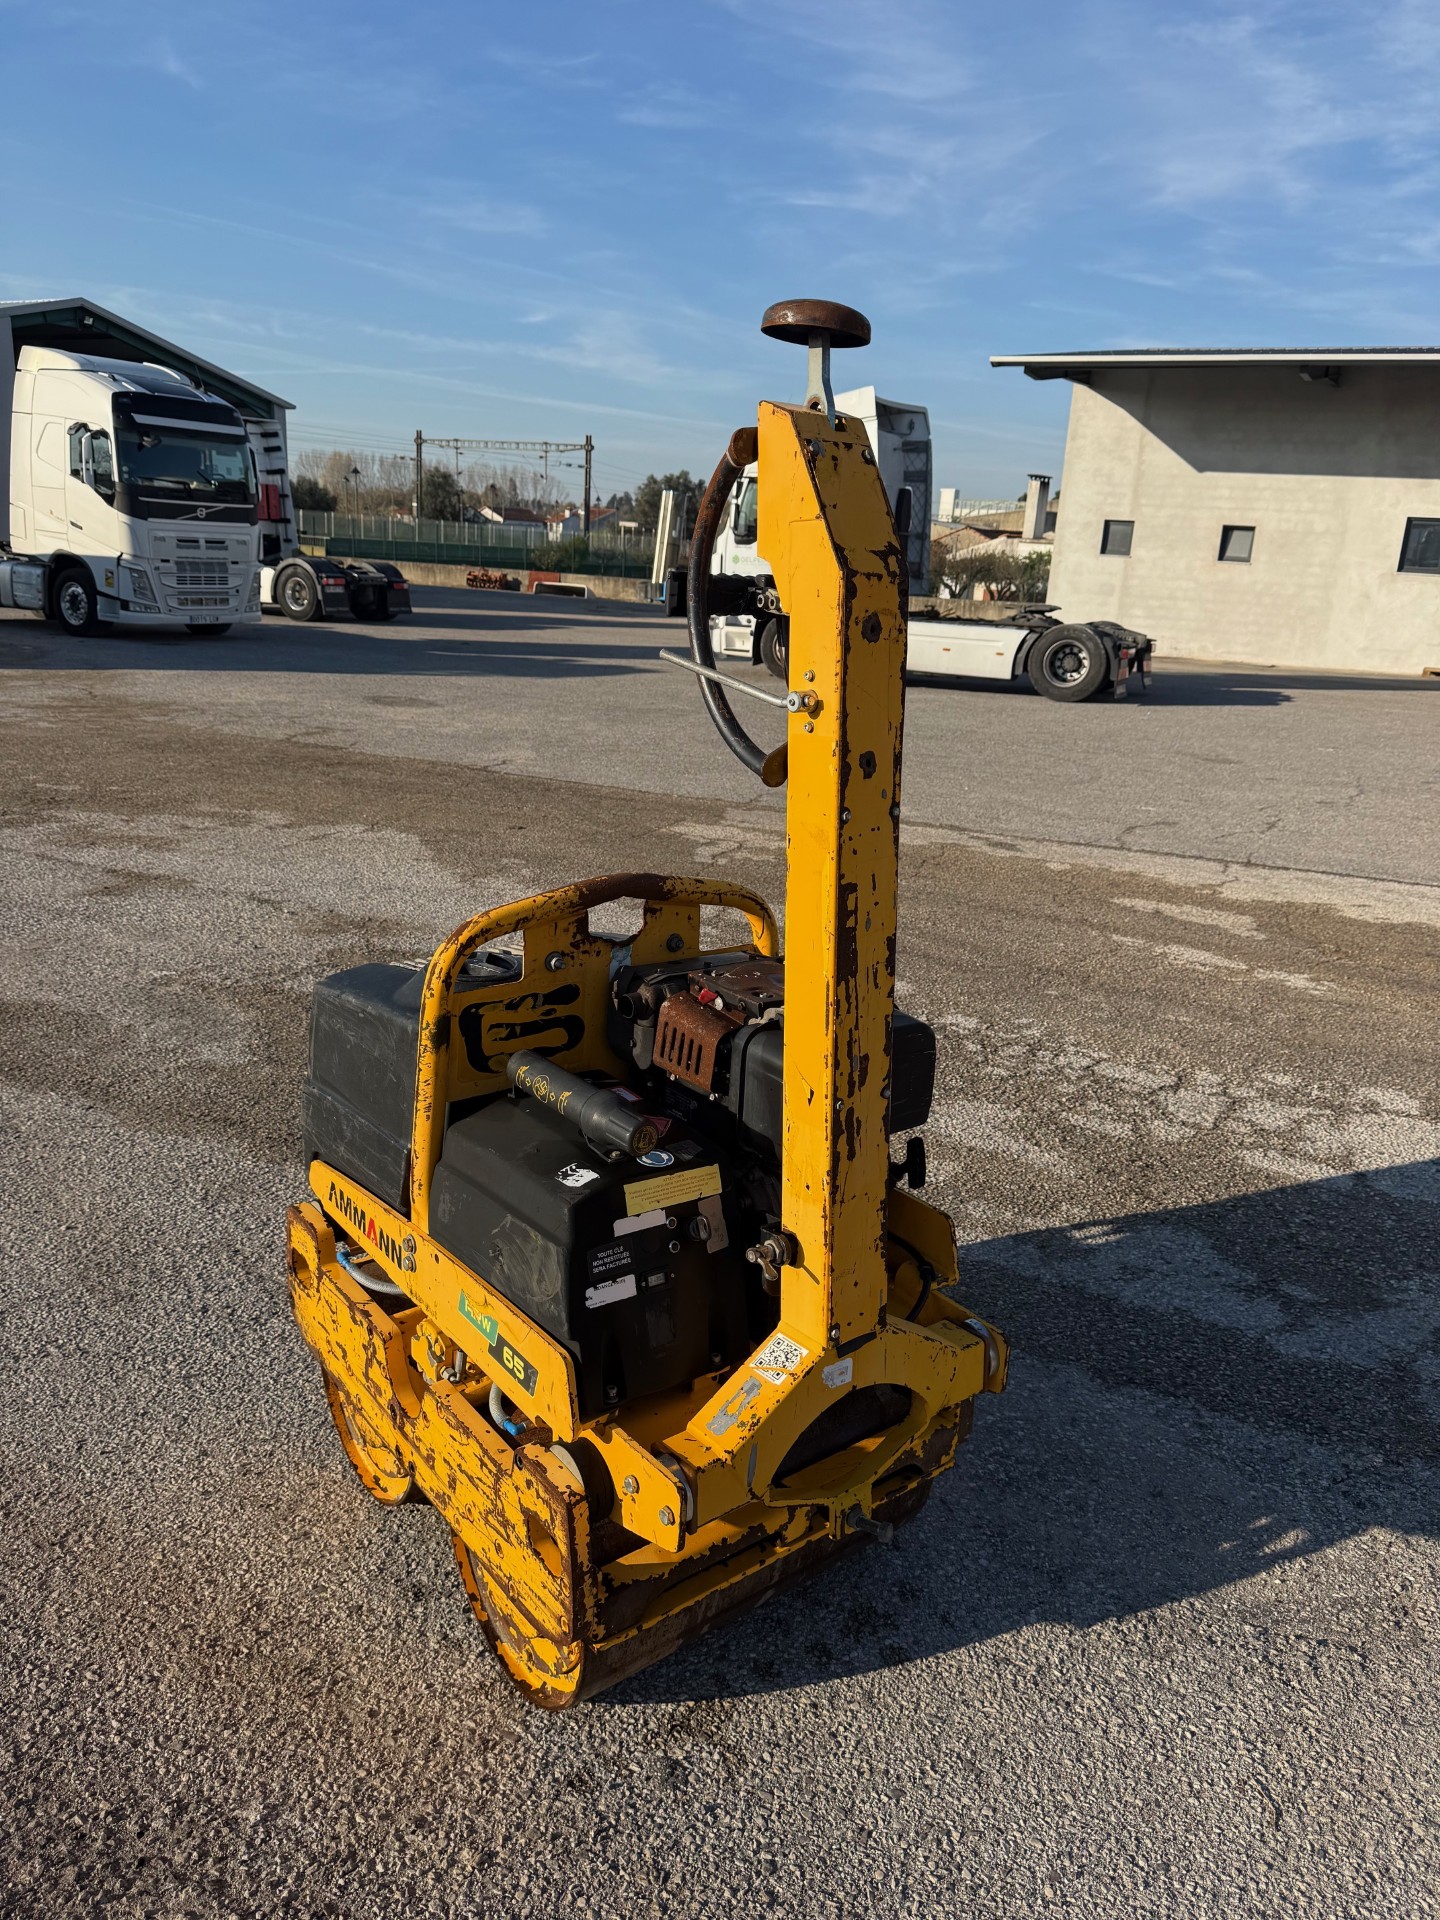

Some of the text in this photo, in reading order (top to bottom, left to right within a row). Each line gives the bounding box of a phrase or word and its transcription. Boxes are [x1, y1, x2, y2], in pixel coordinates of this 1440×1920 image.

[328, 1181, 402, 1269] AMMANN
[597, 1245, 624, 1258] TOUTE CLÉ
[592, 1259, 604, 1267] NON
[592, 1257, 632, 1274] SERA FACTURÉE
[502, 1346, 525, 1381] 65
